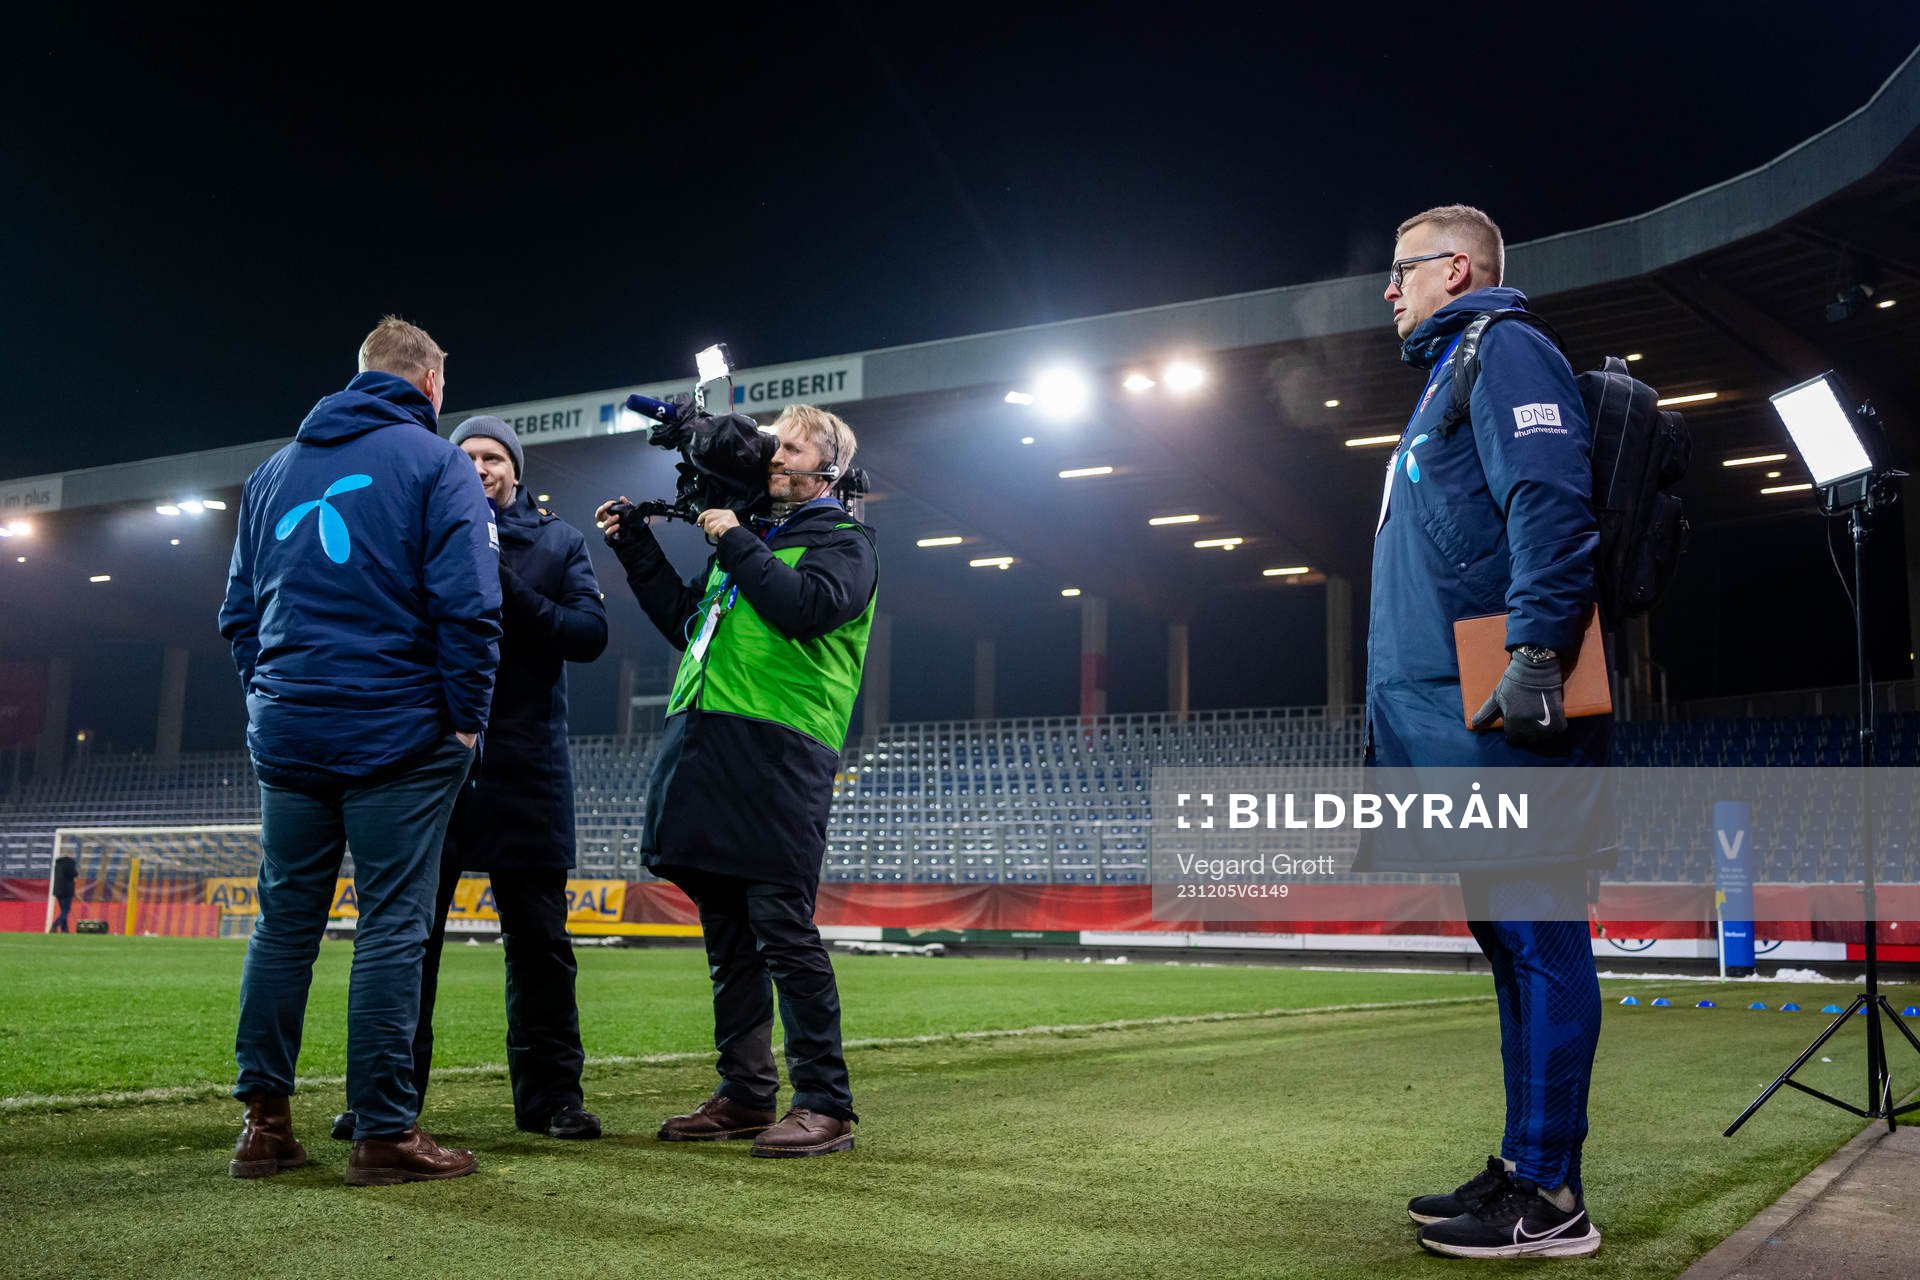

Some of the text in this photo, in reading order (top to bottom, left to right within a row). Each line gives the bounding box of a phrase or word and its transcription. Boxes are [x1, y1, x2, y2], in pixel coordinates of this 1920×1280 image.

[749, 370, 848, 403] GEBERIT
[1520, 404, 1556, 424] DNB
[1717, 830, 1744, 860] V
